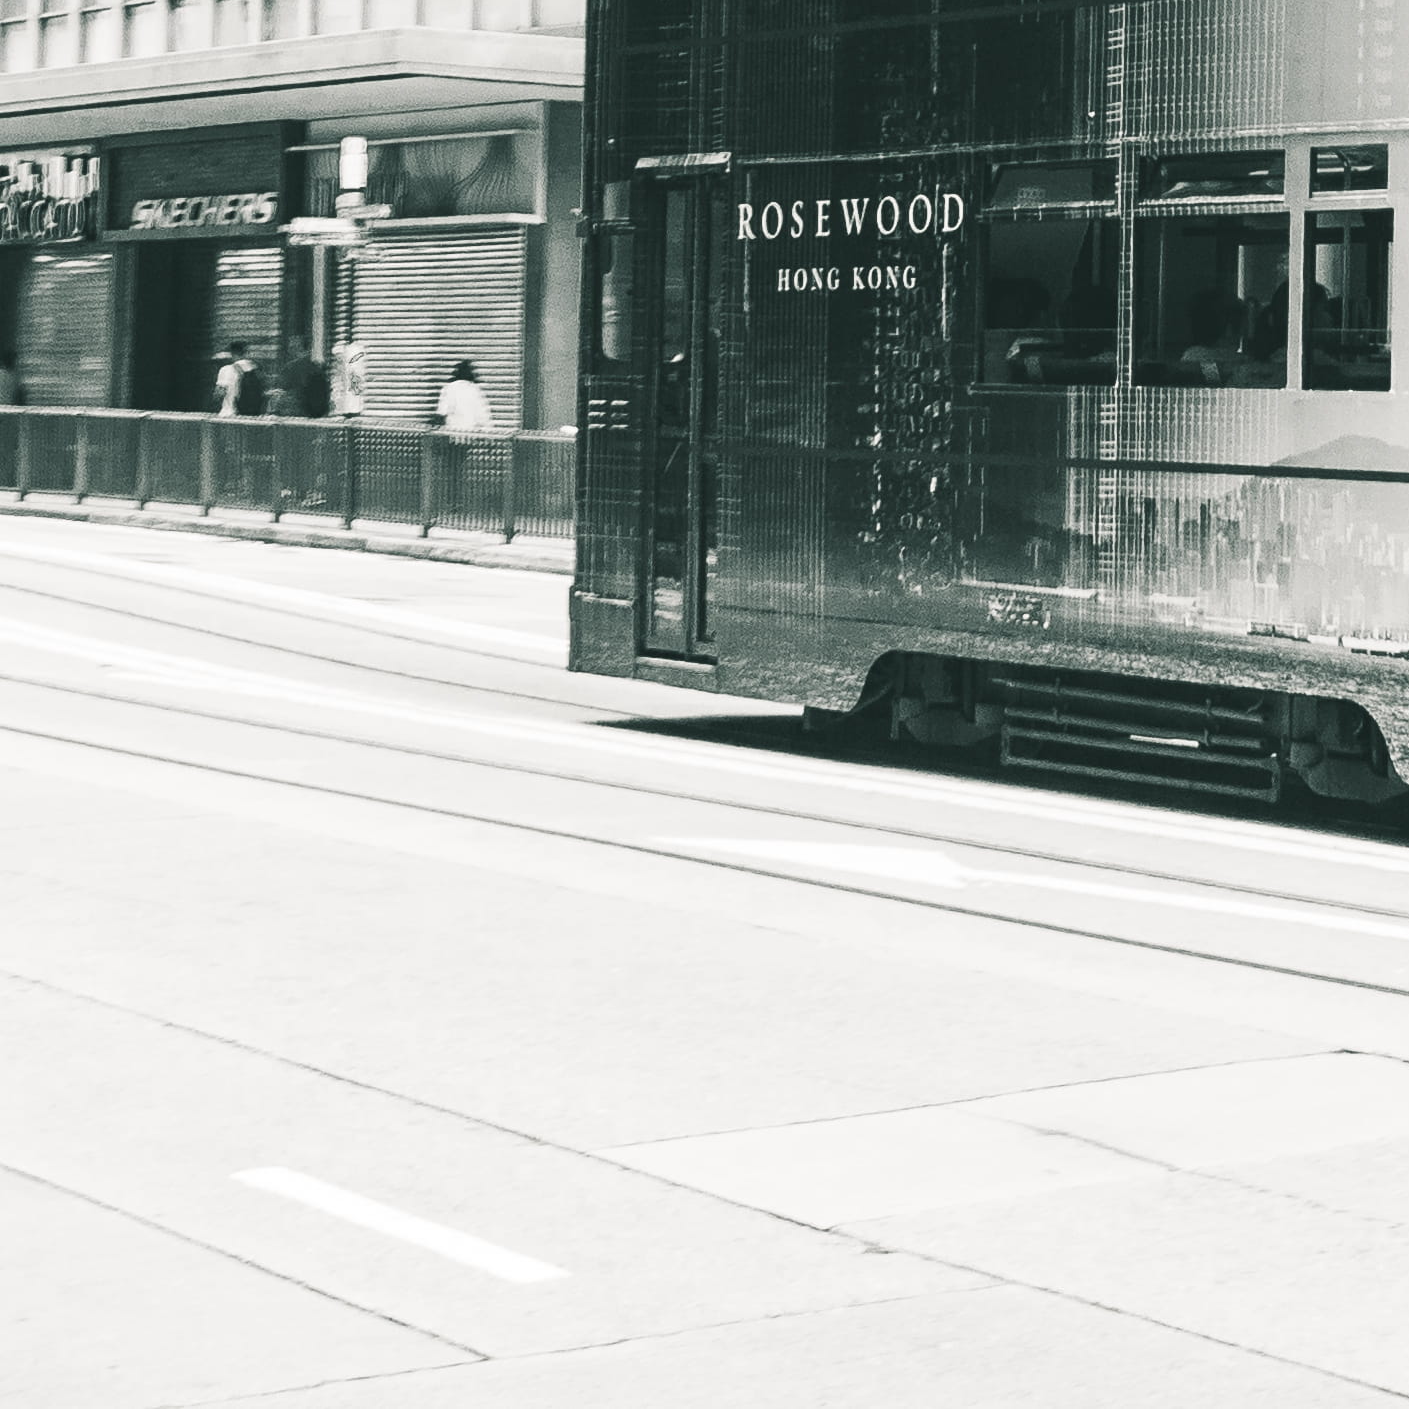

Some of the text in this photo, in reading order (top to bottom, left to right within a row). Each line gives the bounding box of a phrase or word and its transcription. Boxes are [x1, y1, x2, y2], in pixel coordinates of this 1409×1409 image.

[129, 191, 280, 230] SKECHERS
[736, 192, 966, 241] ROSEWOOD
[777, 264, 918, 292] HONG KONG
